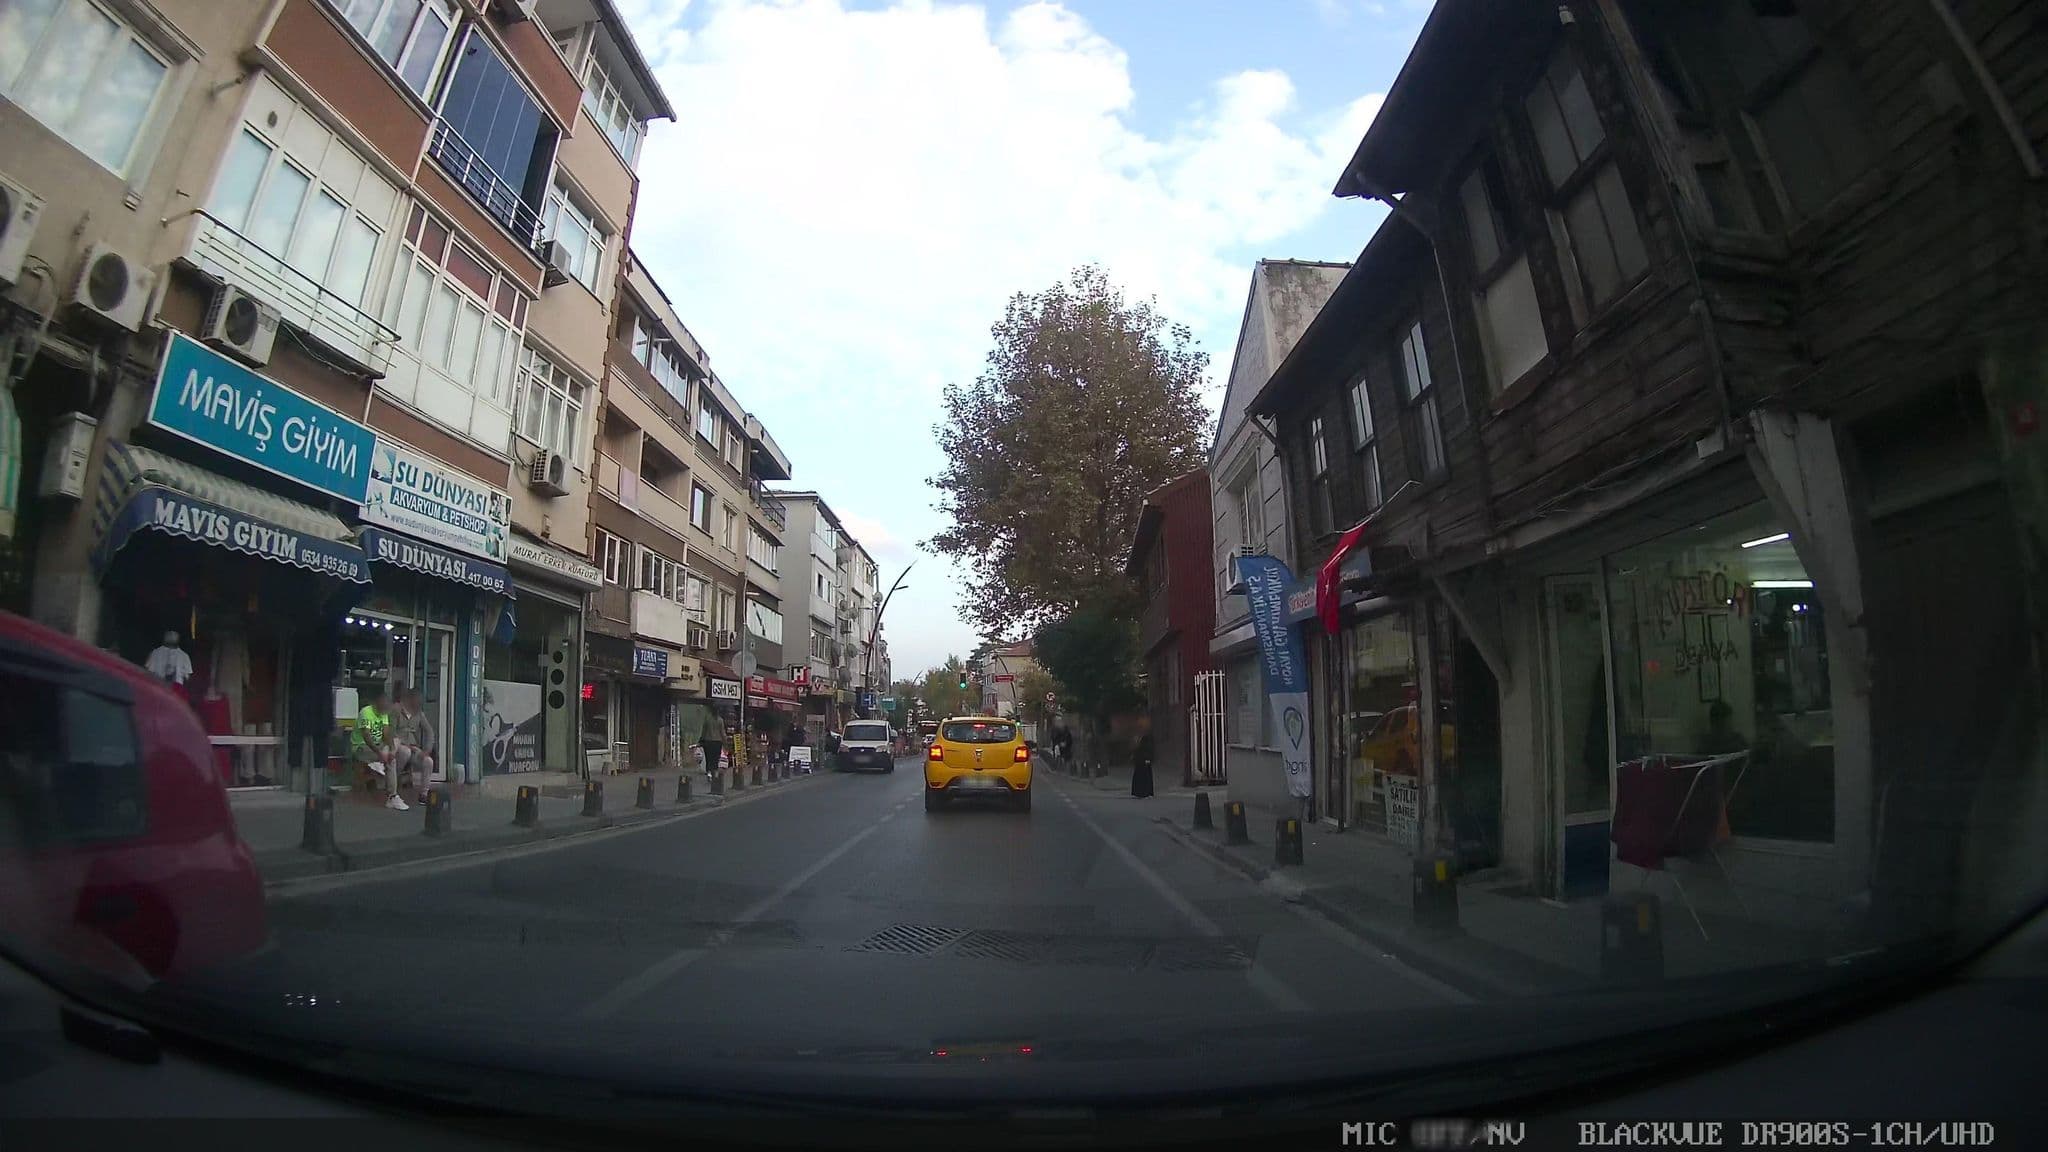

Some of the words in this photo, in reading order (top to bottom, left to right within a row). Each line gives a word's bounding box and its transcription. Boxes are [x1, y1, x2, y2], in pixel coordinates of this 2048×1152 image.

[179, 368, 276, 453] MAVİŞ
[282, 415, 358, 478] GİYİM
[392, 489, 441, 521] AKVARYUM
[441, 508, 449, 522] &
[449, 510, 486, 535] PETSHOP
[395, 461, 419, 489] SU
[421, 471, 488, 516] DÜNYASI
[301, 549, 321, 566] 0534
[322, 556, 337, 571] 935
[337, 560, 348, 575] 26
[378, 537, 399, 560] SU
[401, 545, 468, 579] DÜNYASI
[468, 572, 482, 584] 417
[483, 576, 492, 586] 00
[494, 580, 505, 589] 62
[513, 546, 541, 561] MURAT
